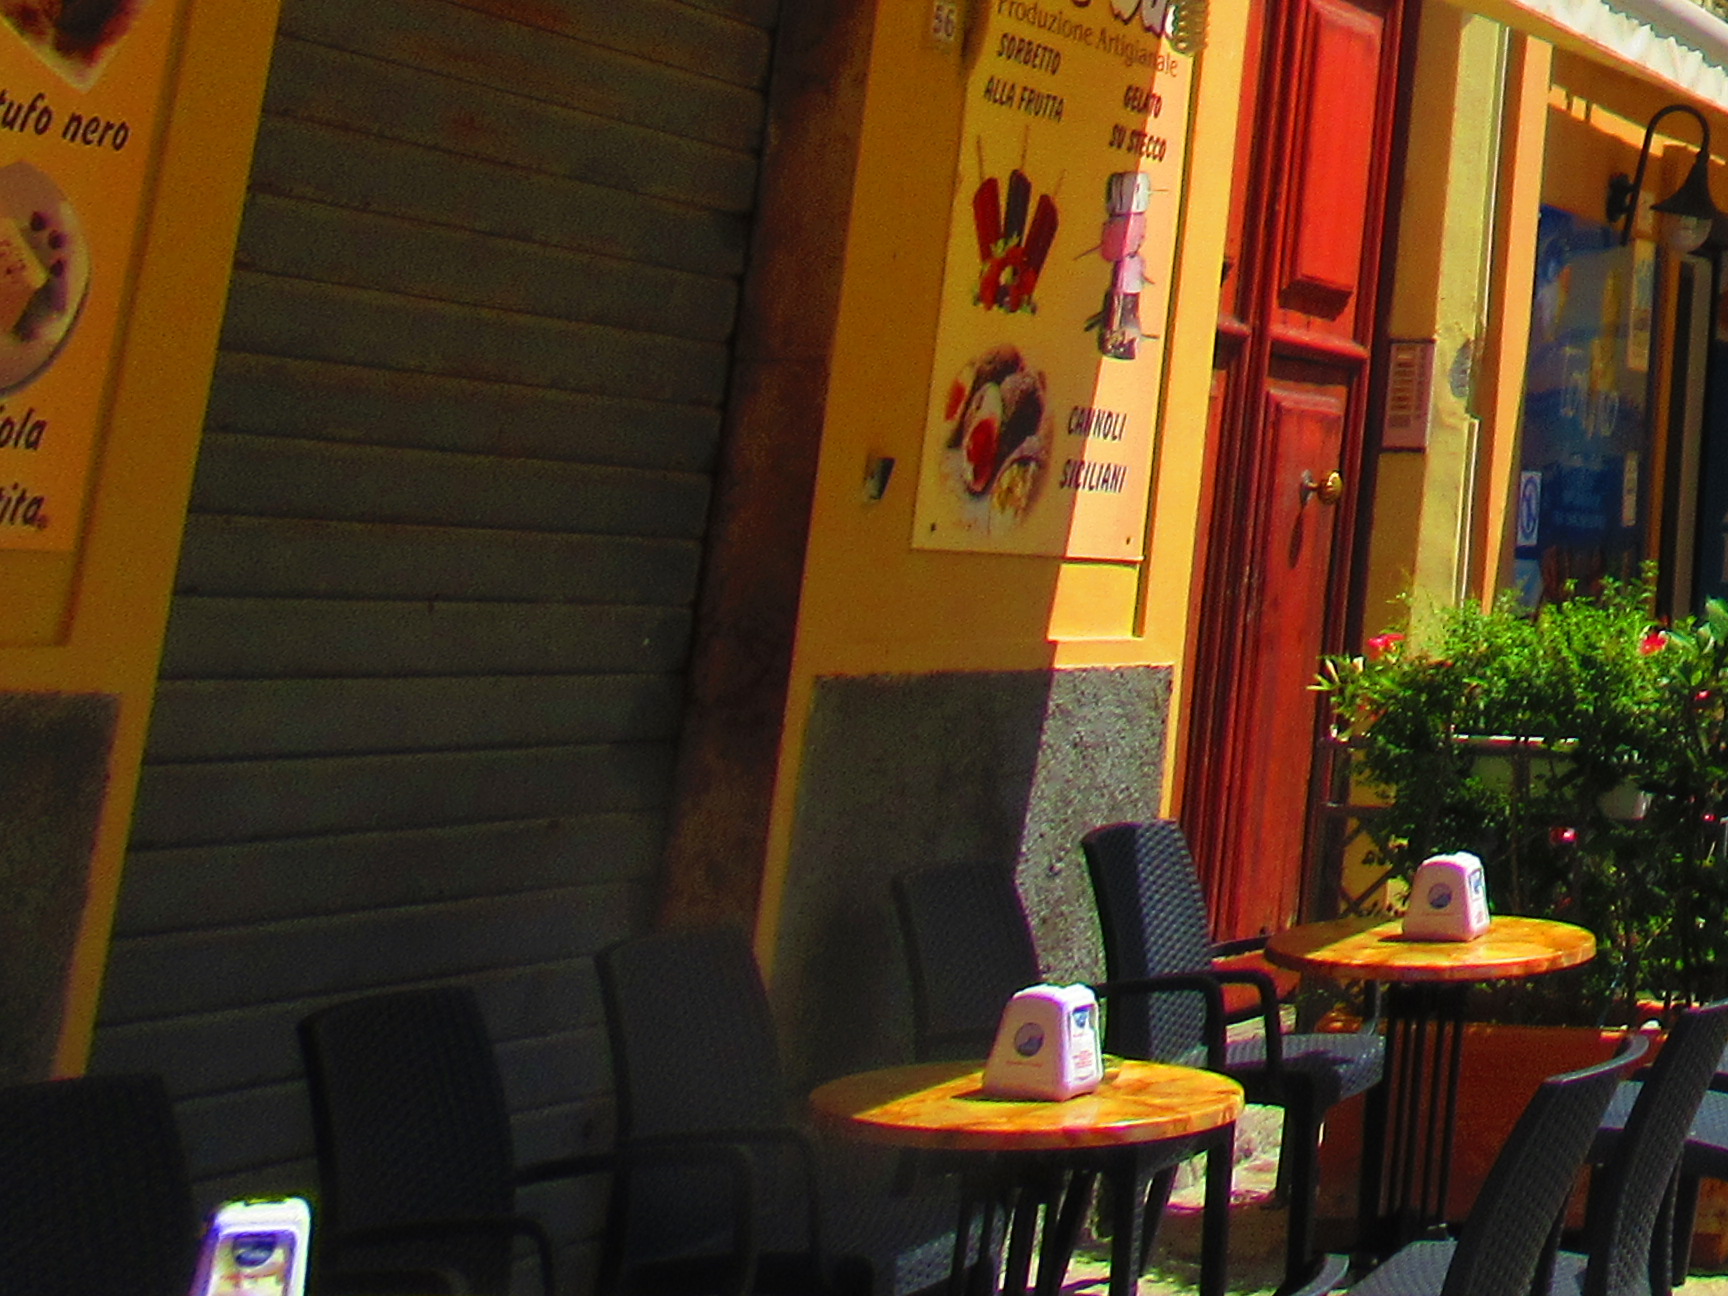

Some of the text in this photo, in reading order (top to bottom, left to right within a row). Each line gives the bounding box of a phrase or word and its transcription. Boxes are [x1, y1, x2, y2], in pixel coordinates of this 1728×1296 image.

[996, 31, 1063, 76] SORBETTO
[1095, 26, 1179, 78] Artigianale
[983, 75, 1066, 123] ALLA FRUTTA
[1123, 83, 1163, 119] GELATO
[61, 111, 131, 152] nero
[1108, 122, 1167, 163] SU STECCO
[1067, 404, 1127, 442] CANNOLI
[1059, 458, 1127, 494] SICILIANI
